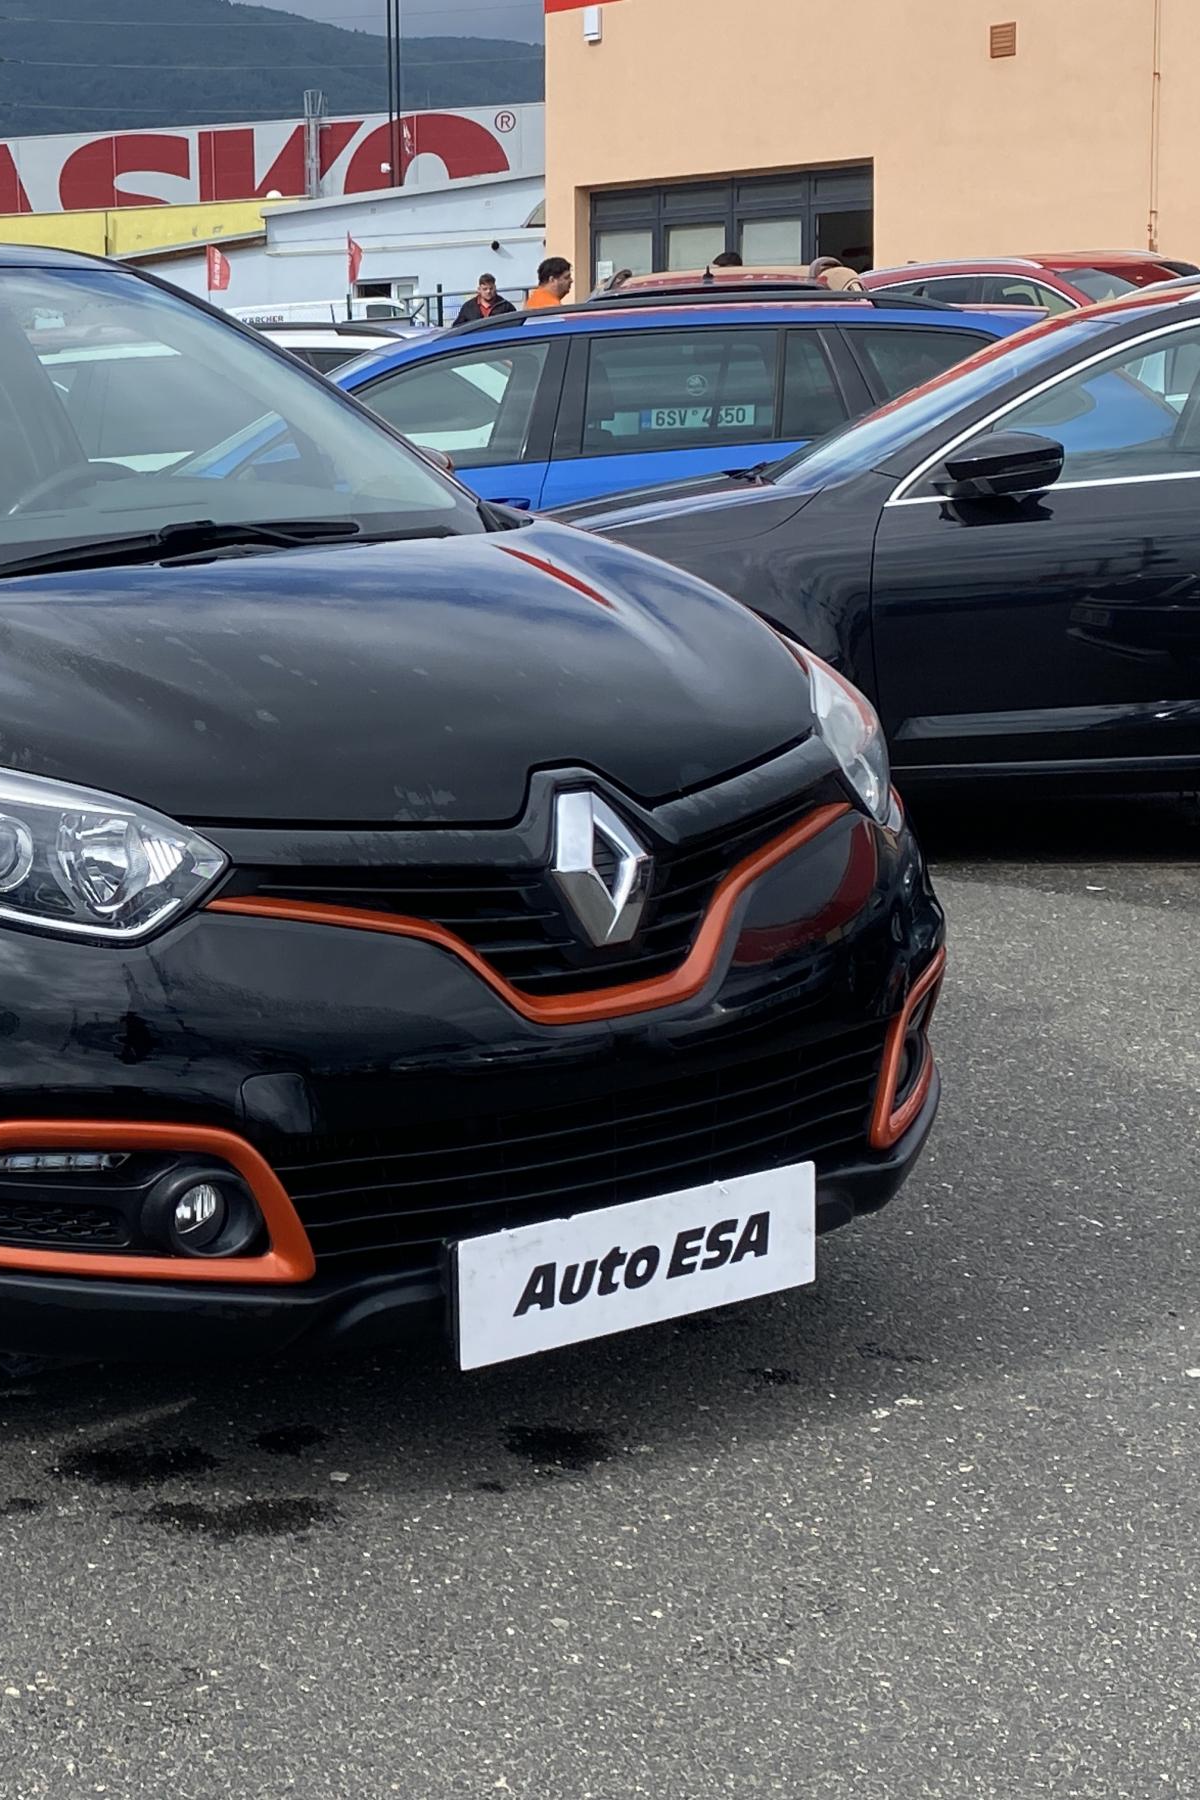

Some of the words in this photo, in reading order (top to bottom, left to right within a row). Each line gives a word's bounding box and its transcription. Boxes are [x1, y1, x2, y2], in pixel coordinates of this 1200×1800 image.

[655, 409, 687, 427] 6SV
[513, 1245, 660, 1317] Auto
[666, 1211, 770, 1279] ESA
